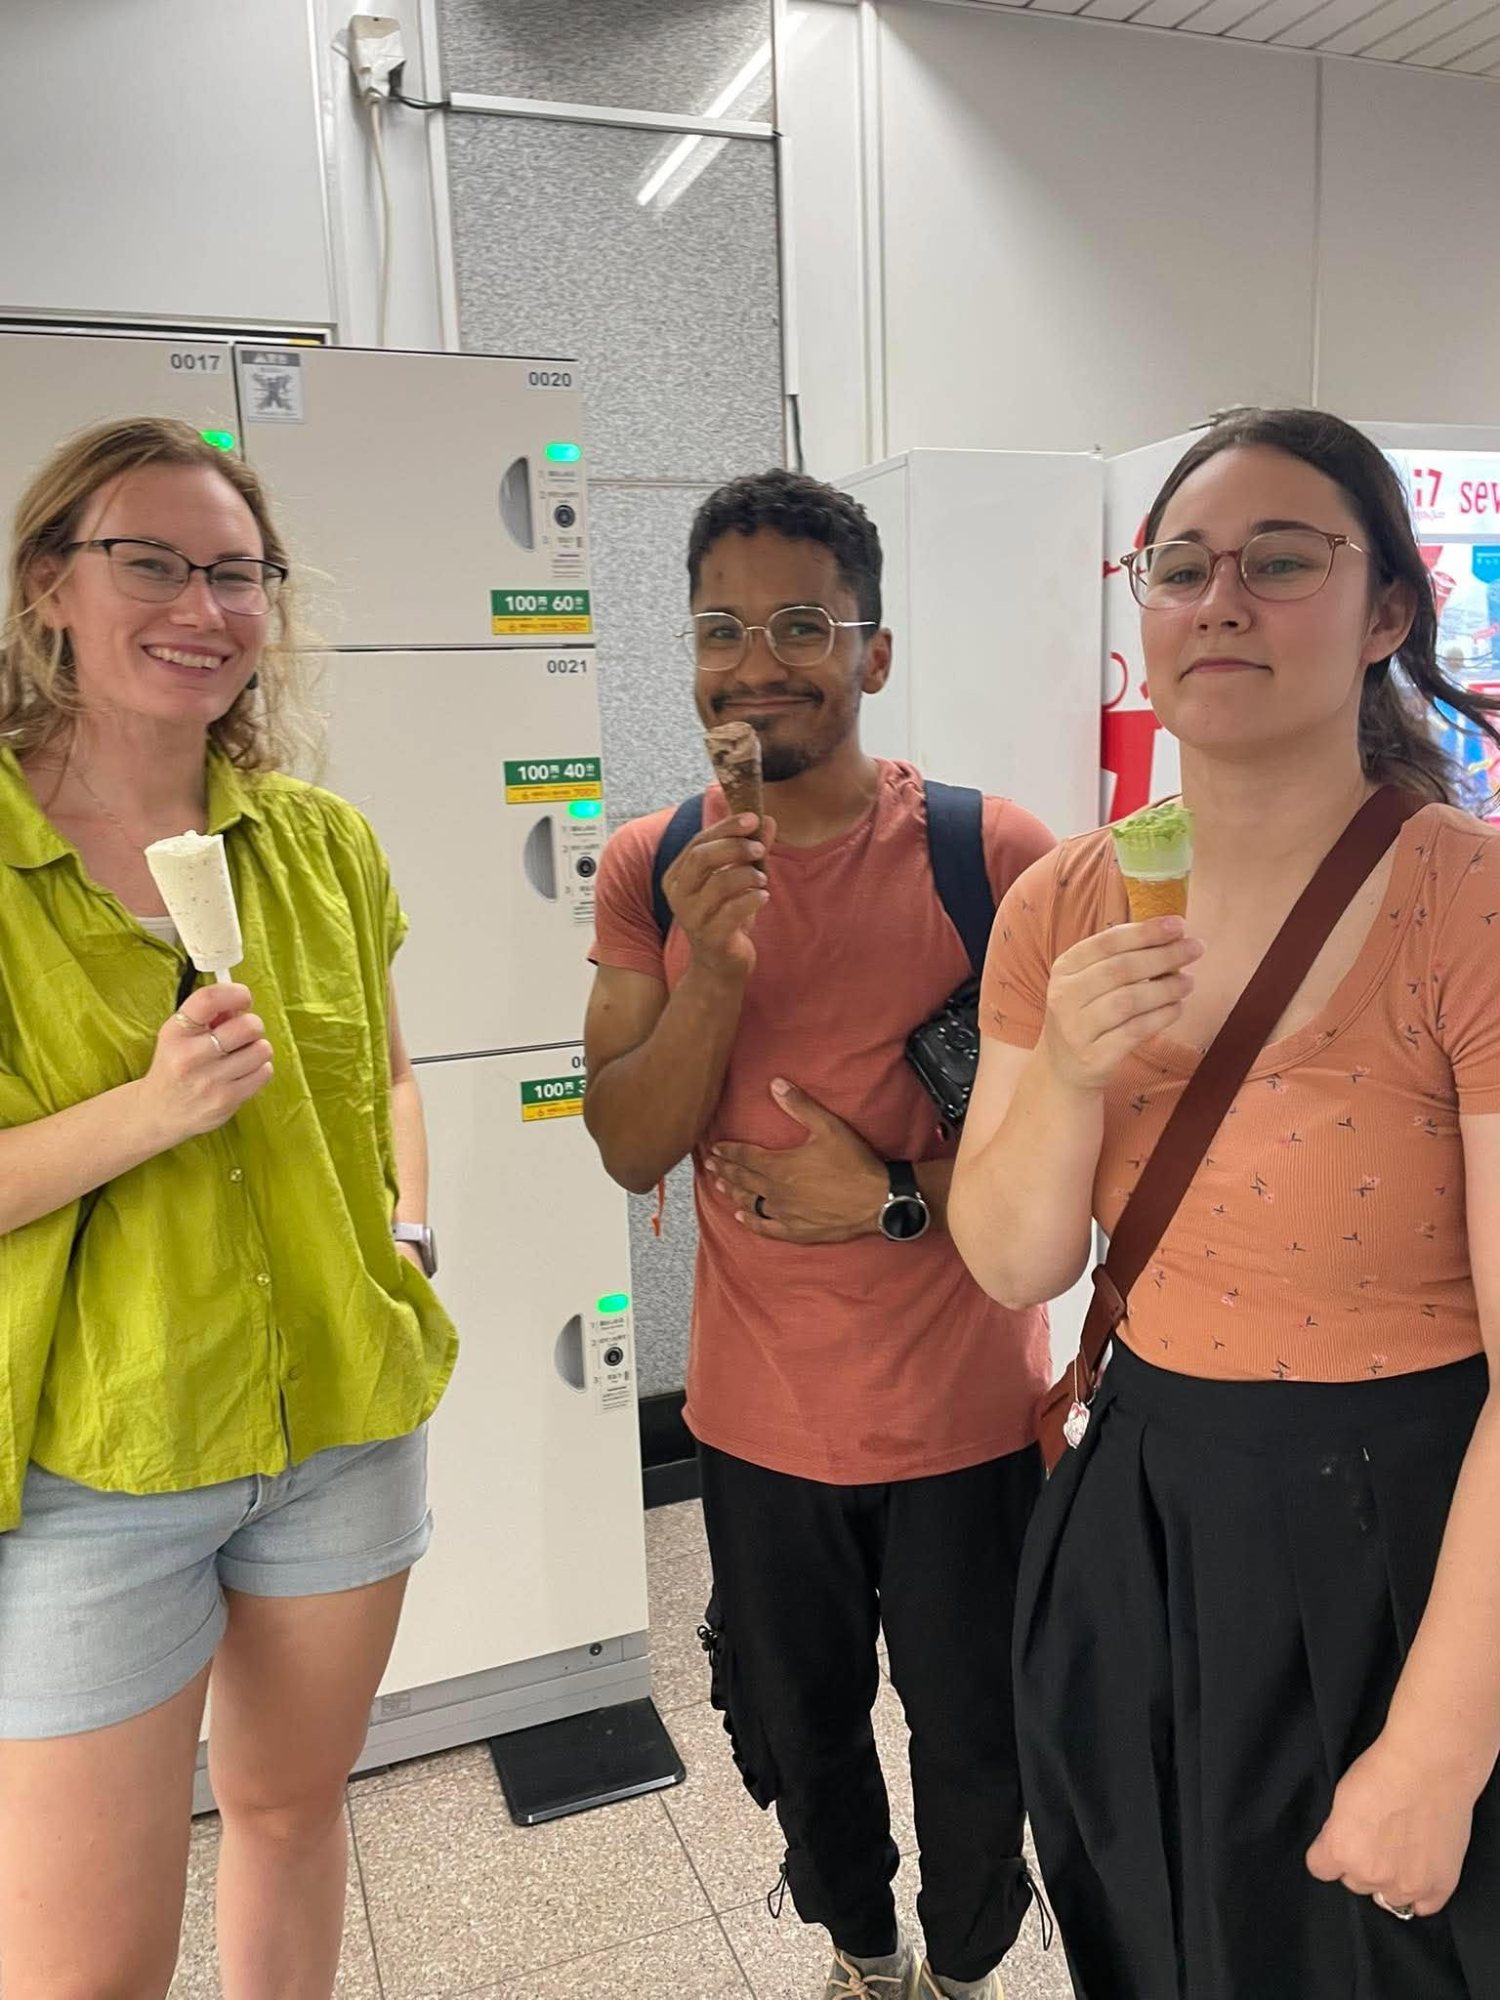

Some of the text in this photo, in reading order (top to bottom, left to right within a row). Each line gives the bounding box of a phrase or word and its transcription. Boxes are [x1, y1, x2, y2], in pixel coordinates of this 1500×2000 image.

[170, 353, 220, 370] 0017
[529, 371, 572, 387] 0020
[547, 659, 587, 674] 0021
